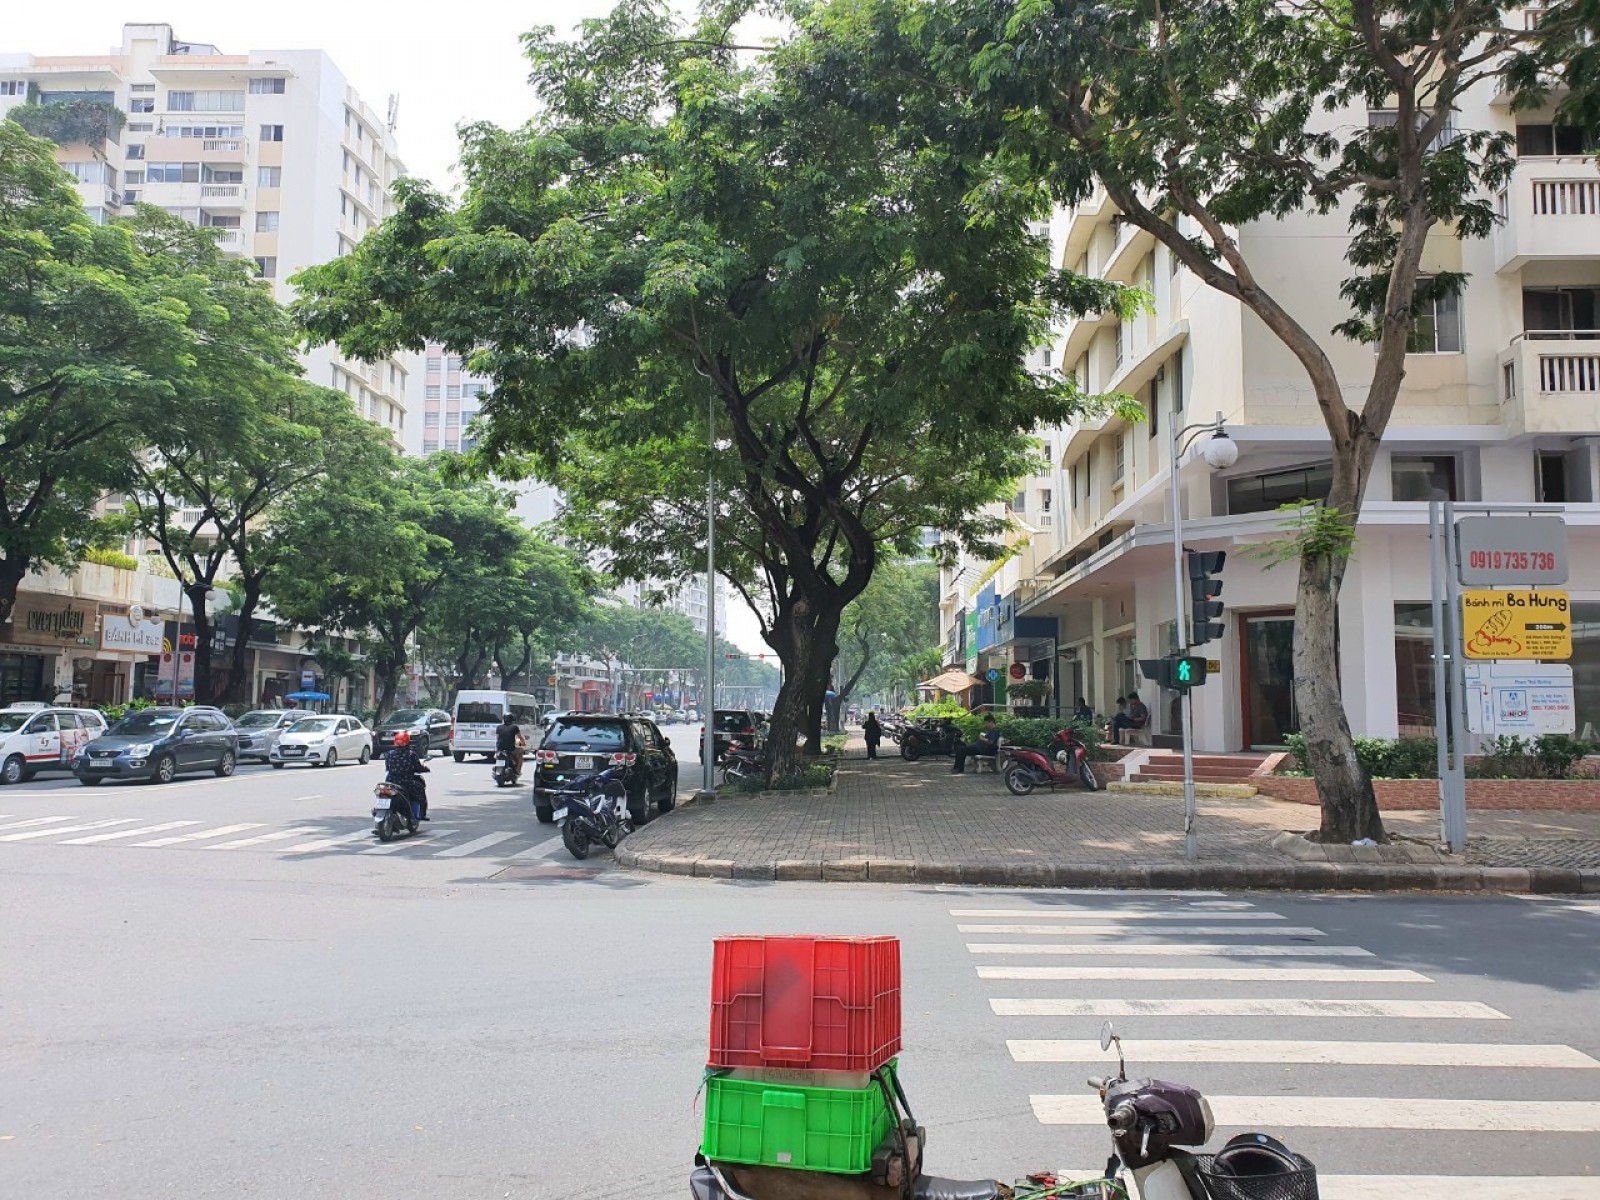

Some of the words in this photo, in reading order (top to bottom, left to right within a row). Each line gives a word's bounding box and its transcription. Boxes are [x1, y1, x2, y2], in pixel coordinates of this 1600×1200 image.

[1470, 551, 1501, 569] 0919
[1504, 552, 1528, 570] 735
[1530, 552, 1555, 570] 736
[1465, 598, 1489, 607] Bánh
[1507, 593, 1525, 607] Ba
[1529, 593, 1567, 611] Hưng
[27, 604, 84, 638] everyday
[105, 627, 132, 643] BÁNH
